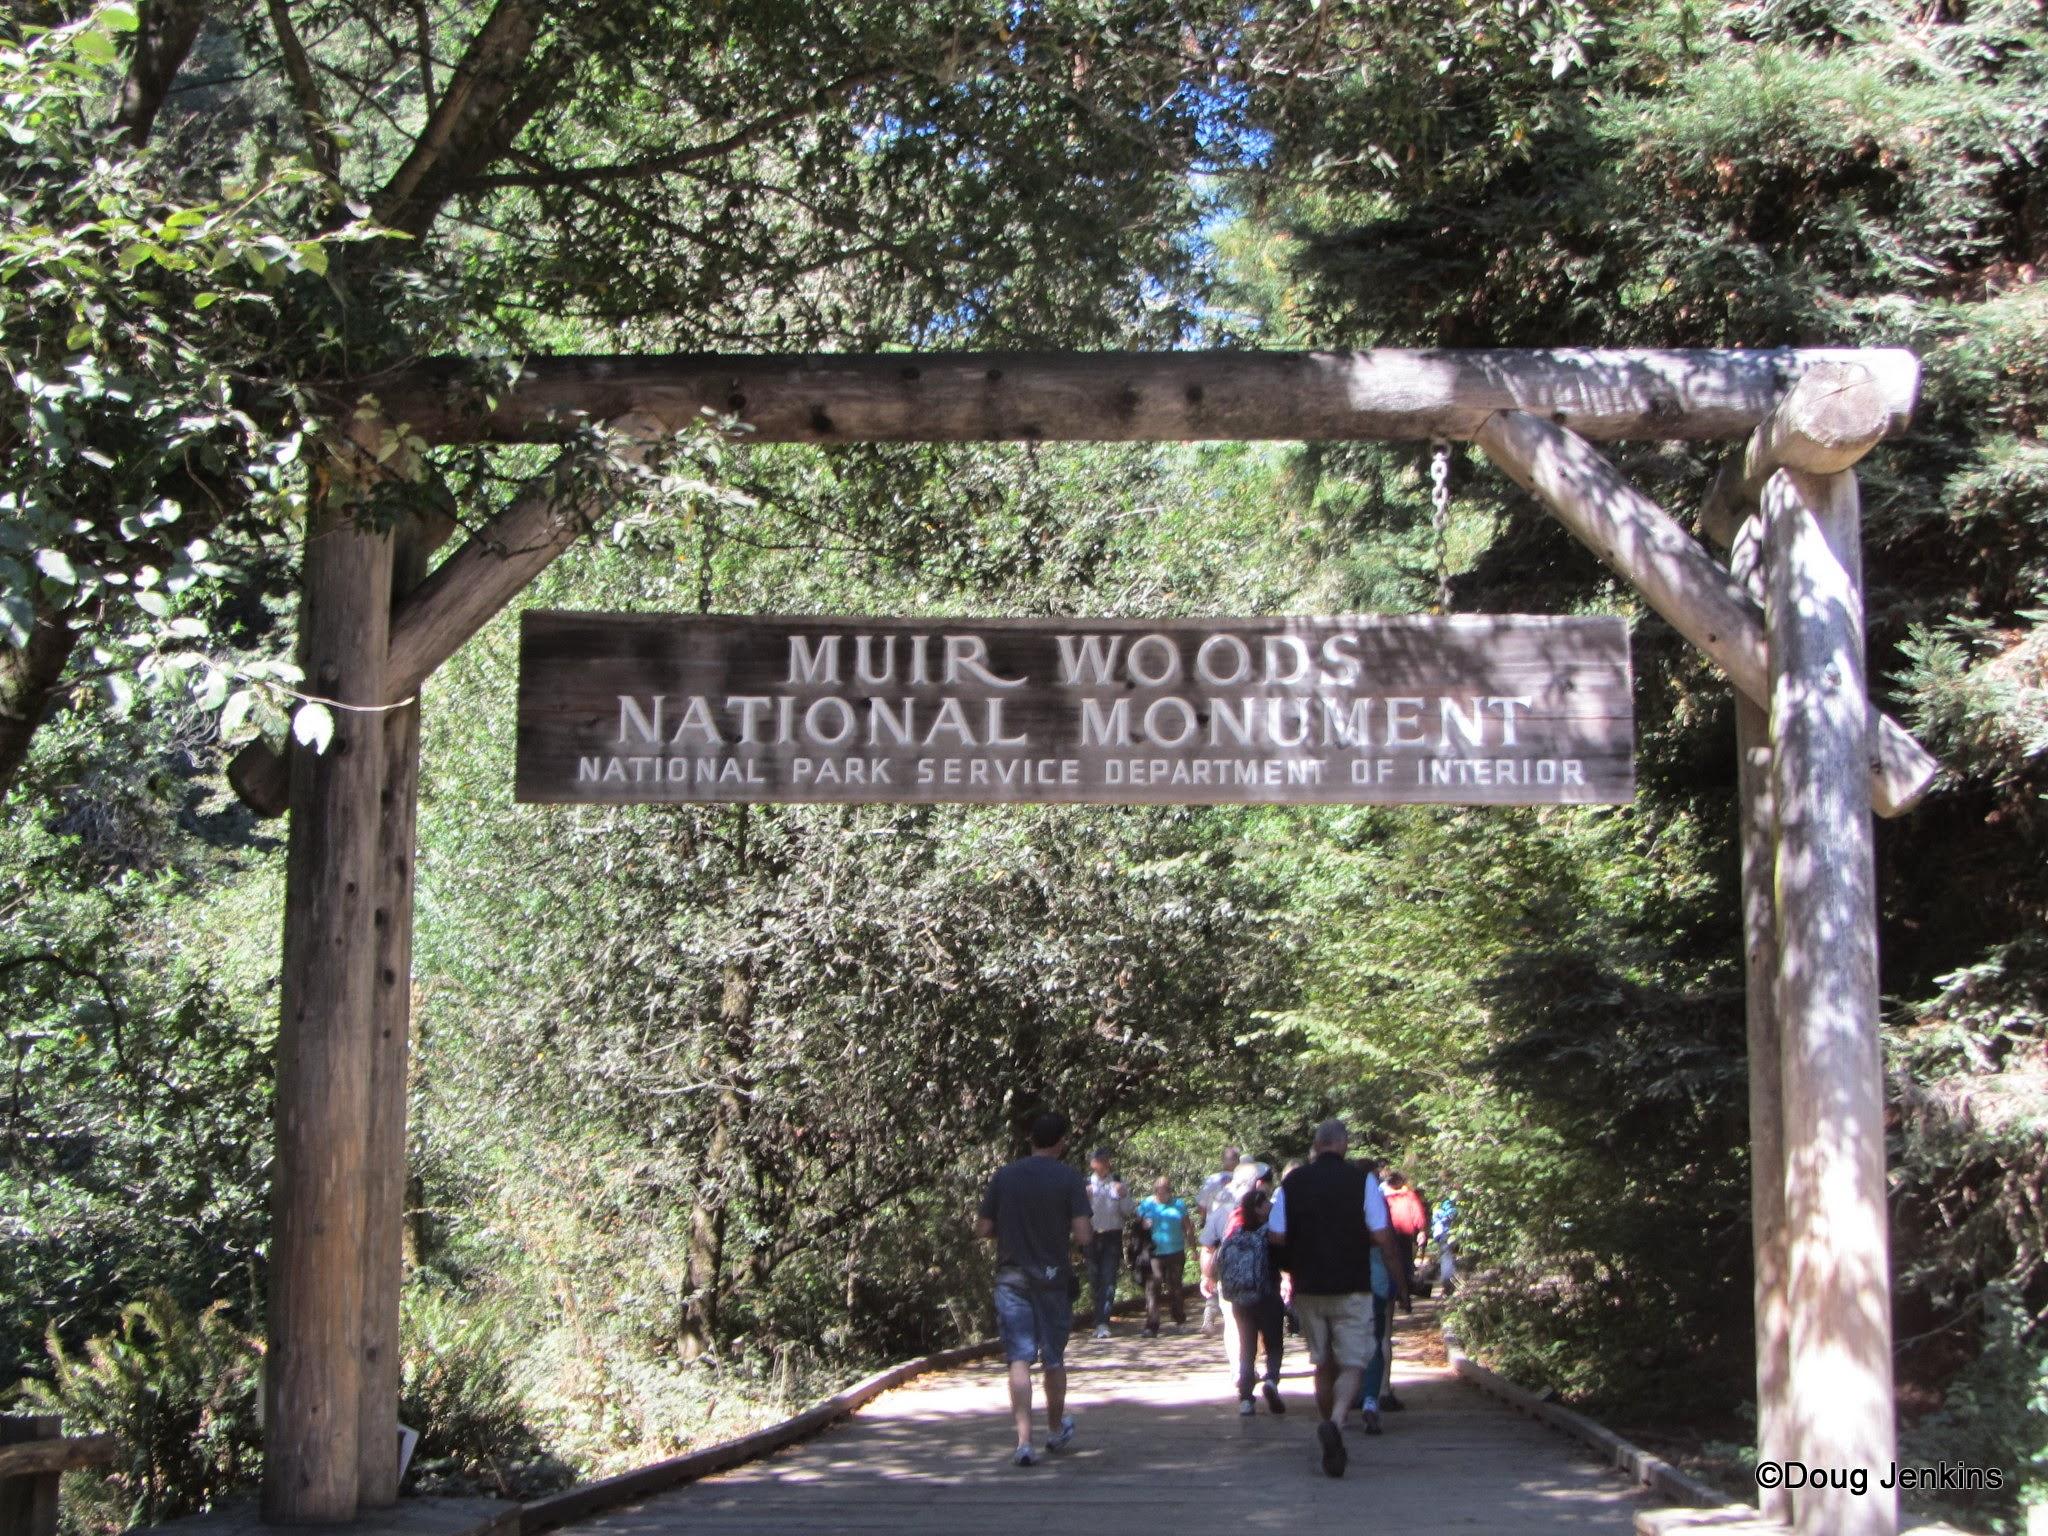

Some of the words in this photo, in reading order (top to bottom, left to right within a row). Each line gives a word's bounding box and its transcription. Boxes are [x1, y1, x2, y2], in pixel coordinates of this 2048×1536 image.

[788, 635, 1029, 688] MUIR
[1055, 634, 1361, 687] WOODS
[616, 695, 1028, 746] NATIONAL
[1080, 696, 1532, 748] MONUMENT
[577, 756, 766, 784] NATIONAL
[793, 758, 892, 785] PARK
[917, 758, 1080, 785] SERVICE
[1105, 759, 1327, 785] DEPARTMENT
[1351, 759, 1394, 785] OF
[1418, 759, 1585, 786] INTERIOR
